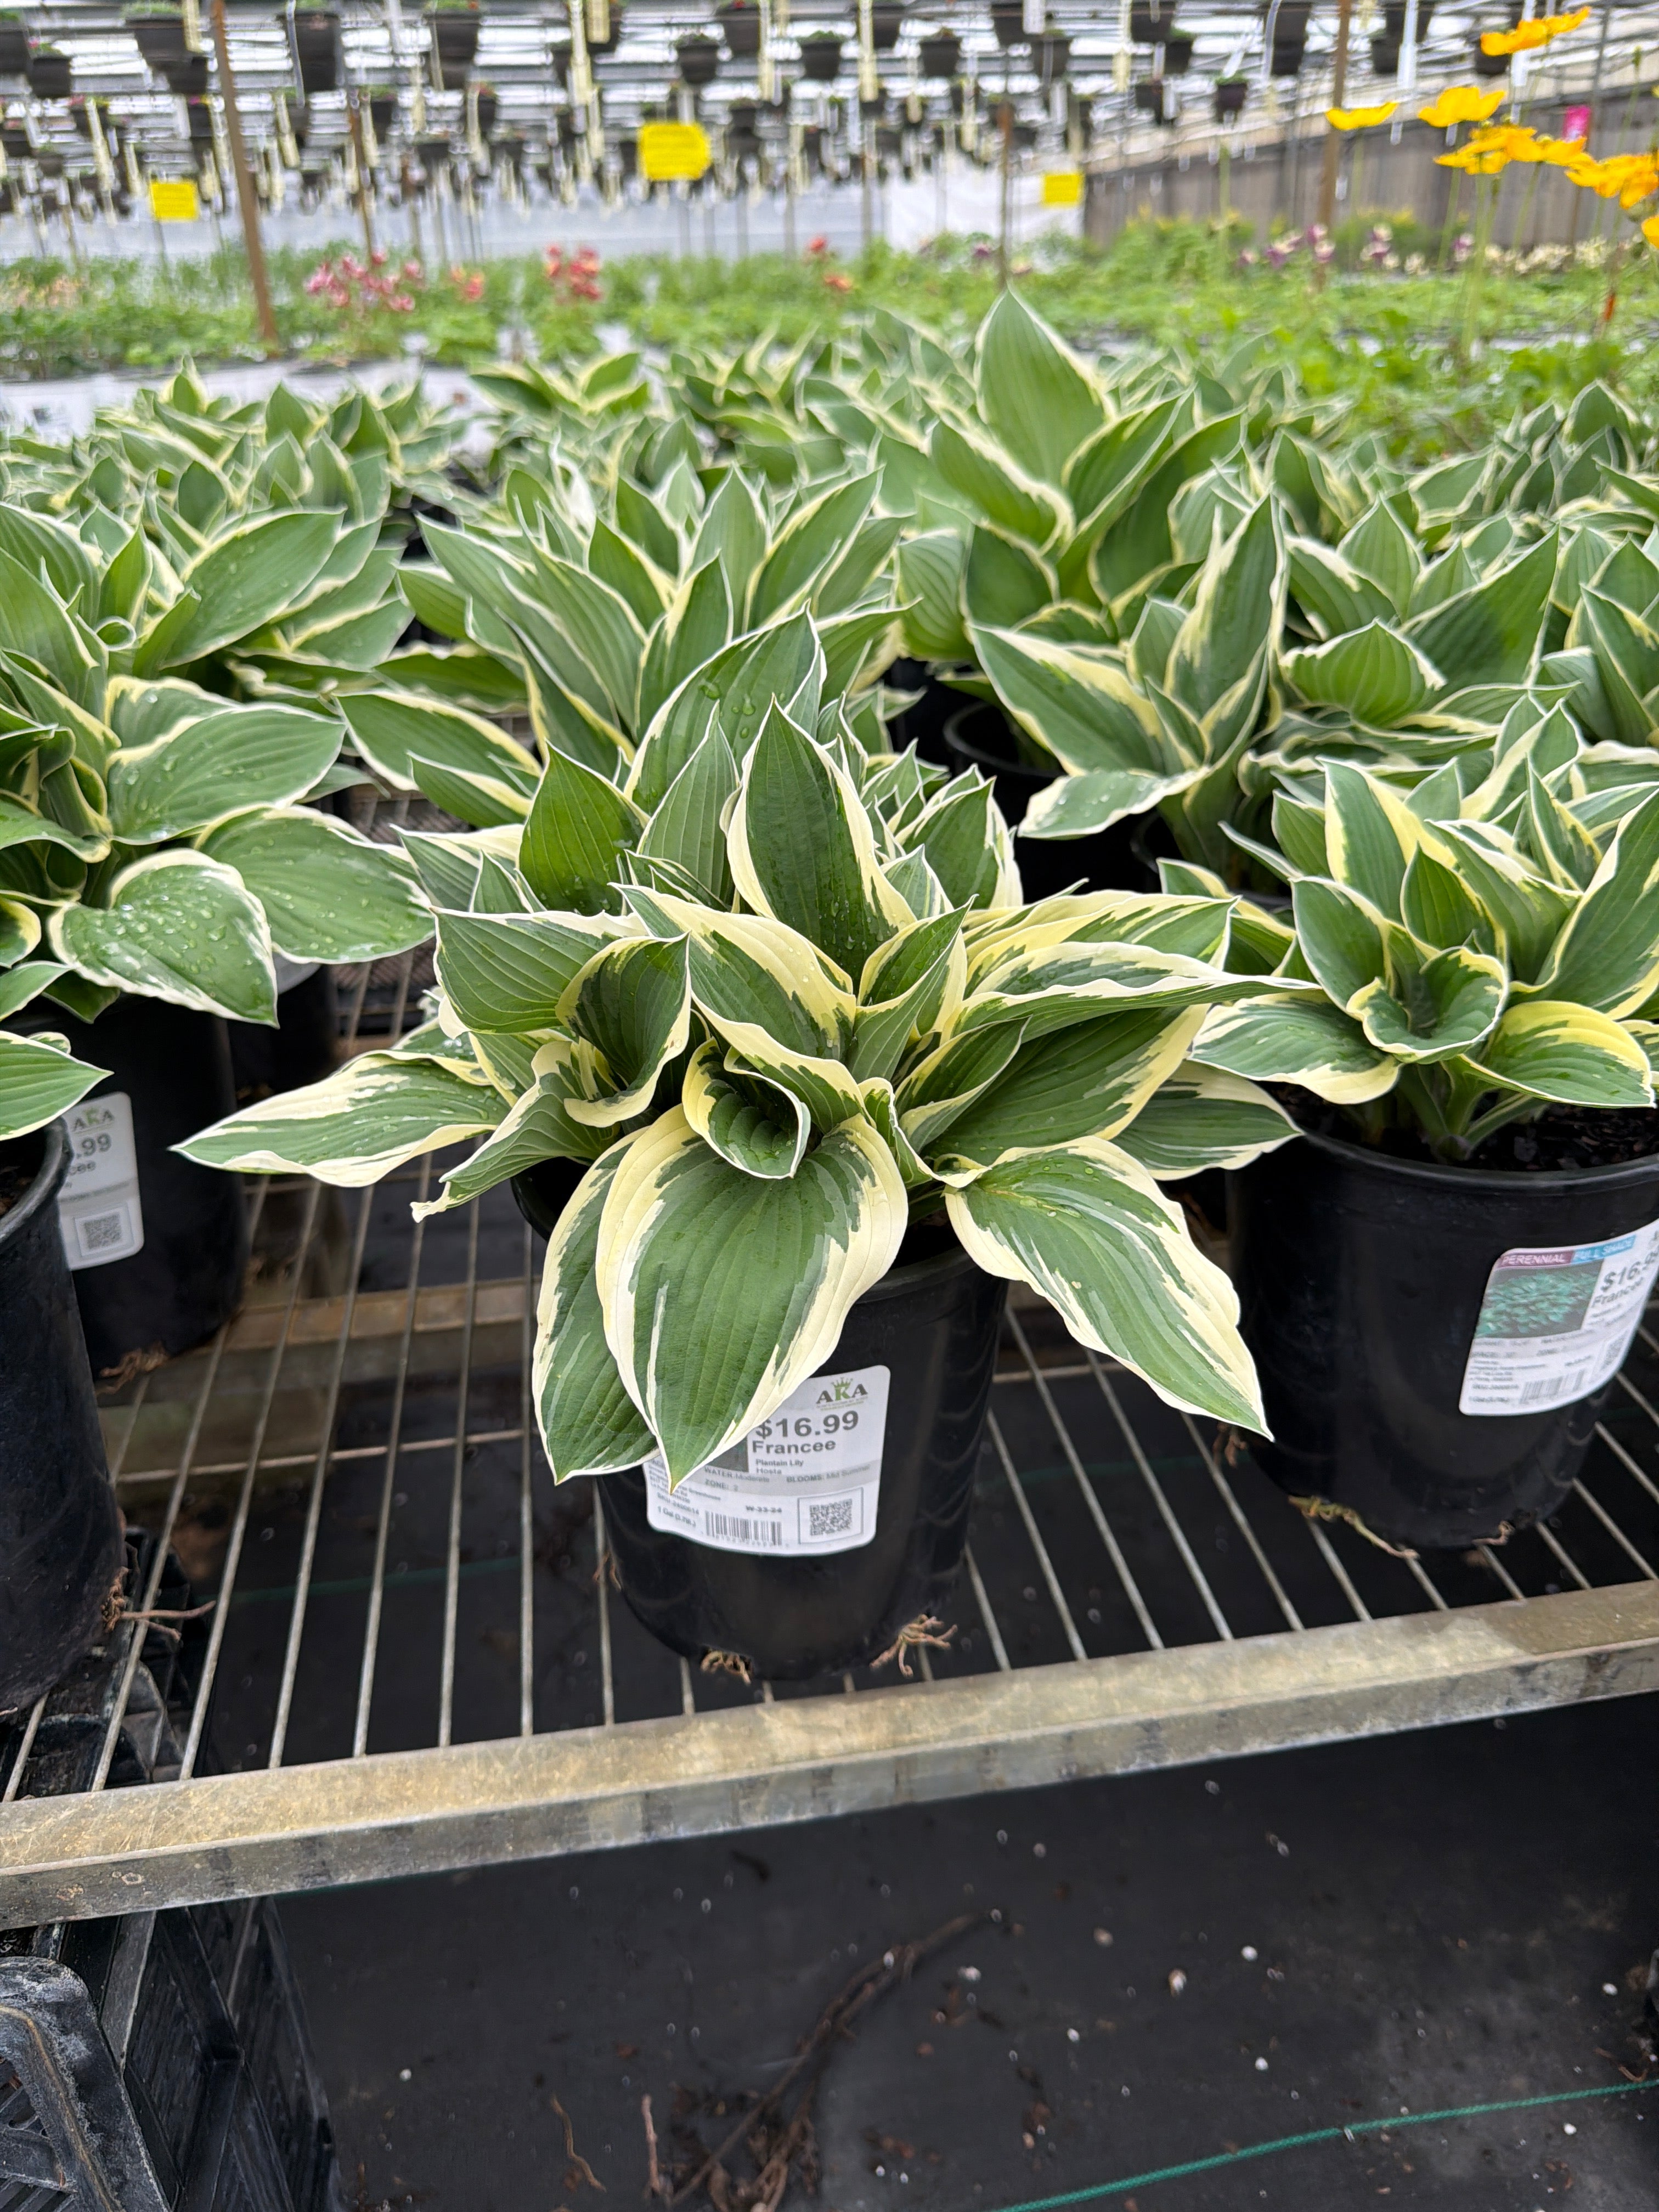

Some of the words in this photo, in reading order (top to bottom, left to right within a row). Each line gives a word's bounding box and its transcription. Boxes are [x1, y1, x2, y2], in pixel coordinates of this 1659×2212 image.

[72, 1108, 114, 1132] AKA
[76, 1133, 112, 1157] .99
[1501, 1254, 1565, 1265] PERENNIAL
[1571, 1249, 1599, 1261] FULL
[1592, 1277, 1644, 1308] Francee
[816, 1380, 868, 1404] AKA
[755, 1410, 859, 1440] $16.99
[752, 1440, 836, 1454] Francee
[755, 1458, 788, 1466] Plantain
[789, 1459, 804, 1467] Lily
